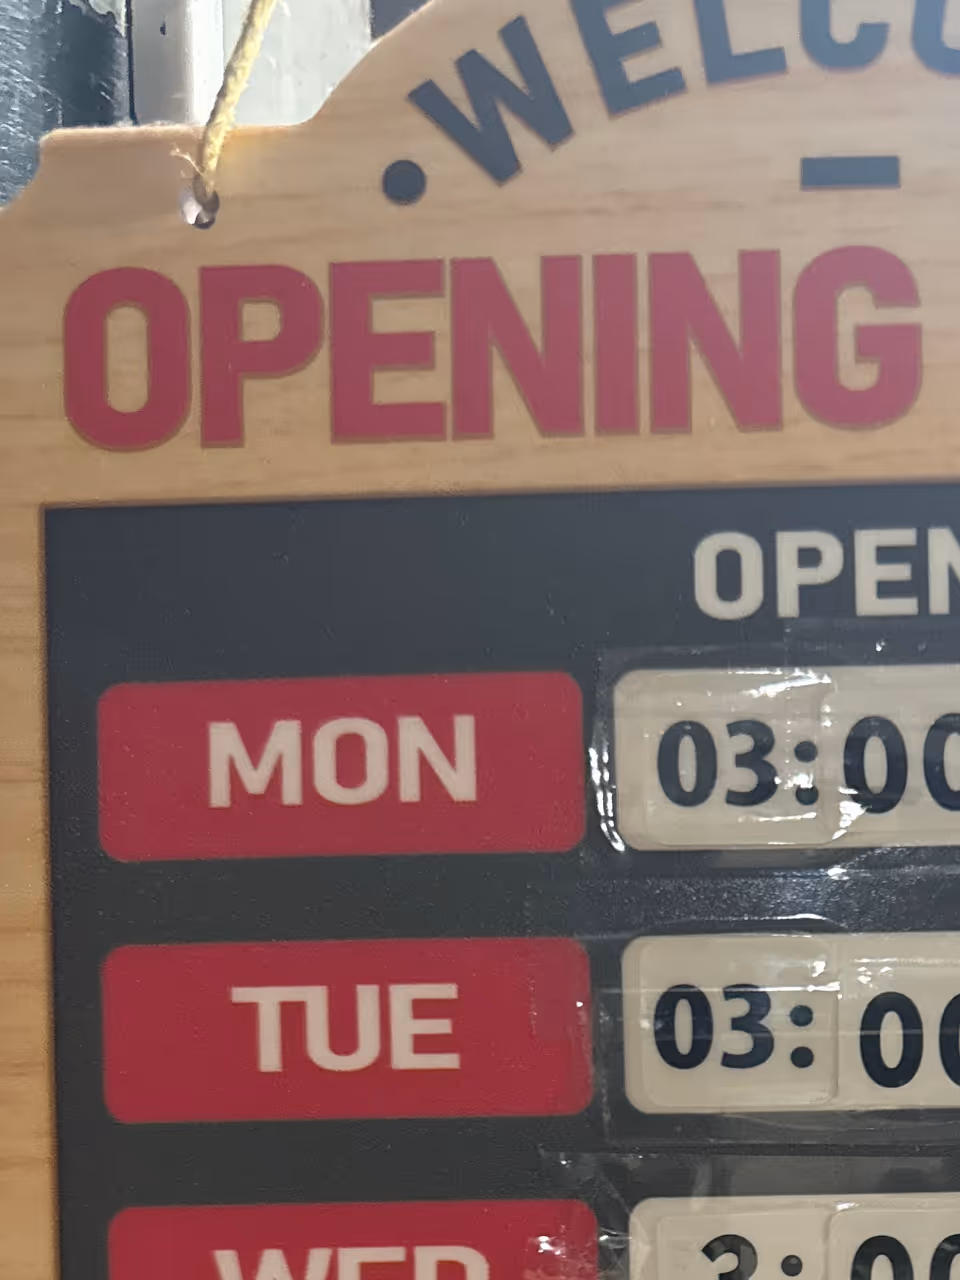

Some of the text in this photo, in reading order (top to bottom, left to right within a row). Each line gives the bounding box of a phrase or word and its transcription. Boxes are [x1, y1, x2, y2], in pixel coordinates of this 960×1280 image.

[62, 244, 924, 452] OPENING
[207, 715, 478, 808] MON
[231, 984, 460, 1072] TUE
